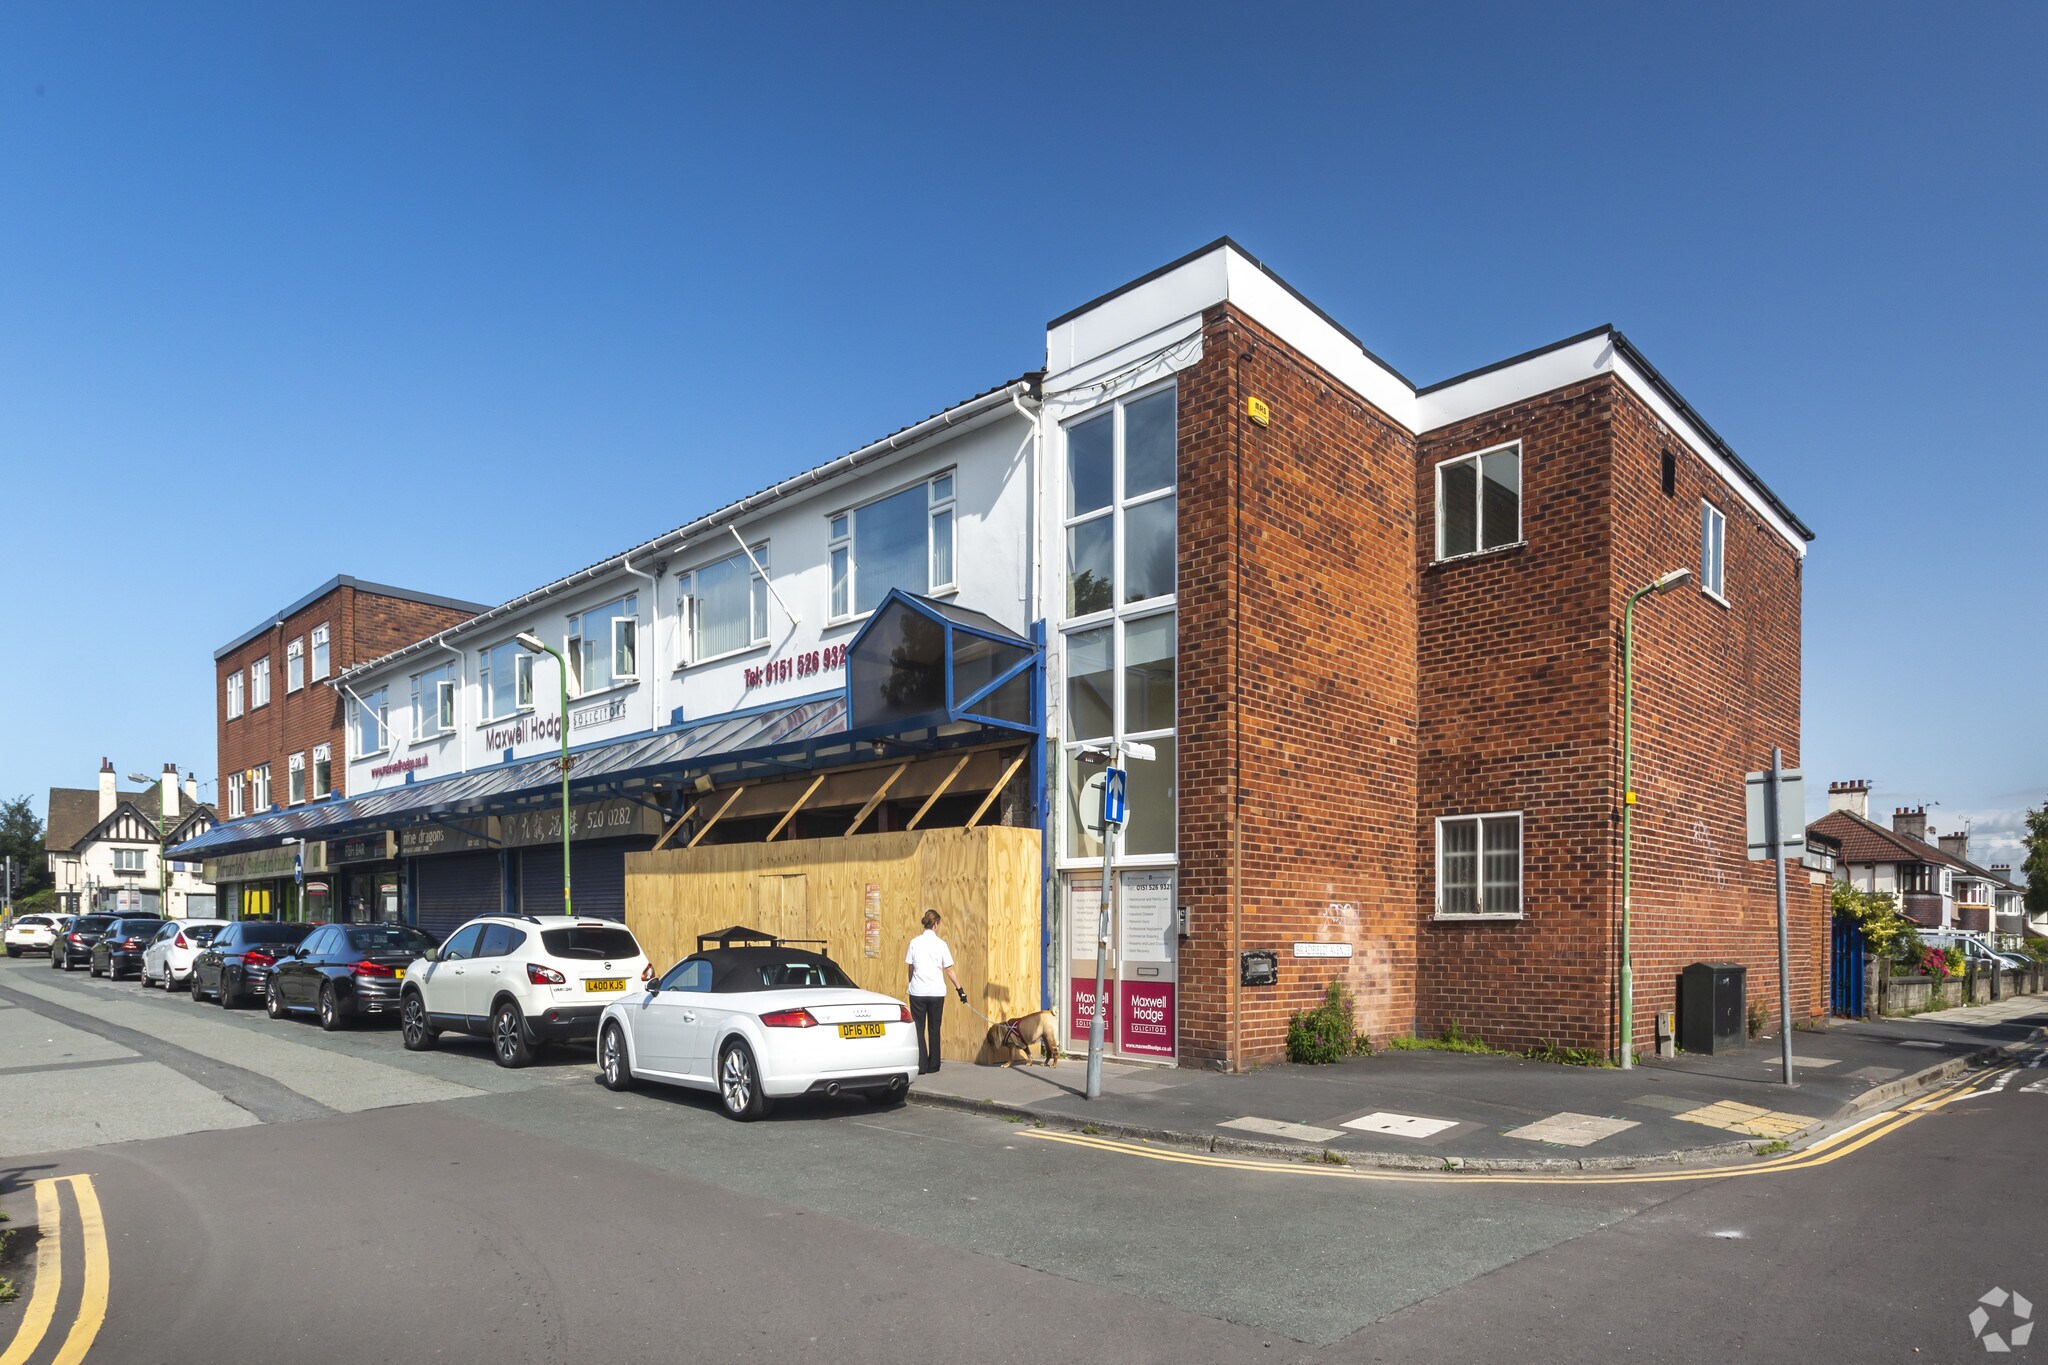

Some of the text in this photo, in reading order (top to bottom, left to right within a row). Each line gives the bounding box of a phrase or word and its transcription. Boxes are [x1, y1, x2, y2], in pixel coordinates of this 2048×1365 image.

[744, 666, 763, 688] Tel:
[765, 657, 793, 683] 0151
[797, 650, 819, 676] 526
[573, 703, 626, 728] SOLICITORS
[485, 718, 528, 752] Maxwell
[587, 811, 604, 829] 520
[608, 806, 630, 827] 0282
[403, 829, 444, 847] nine dragons
[588, 981, 624, 990] L400 KJS
[1076, 991, 1109, 1004] Maxell
[1131, 995, 1167, 1008] Maxwell
[1078, 1003, 1106, 1016] Hode
[1133, 1007, 1163, 1023] Hodge
[843, 1023, 881, 1036] DF16 YRO
[1131, 1025, 1167, 1033] SOLICITORS
